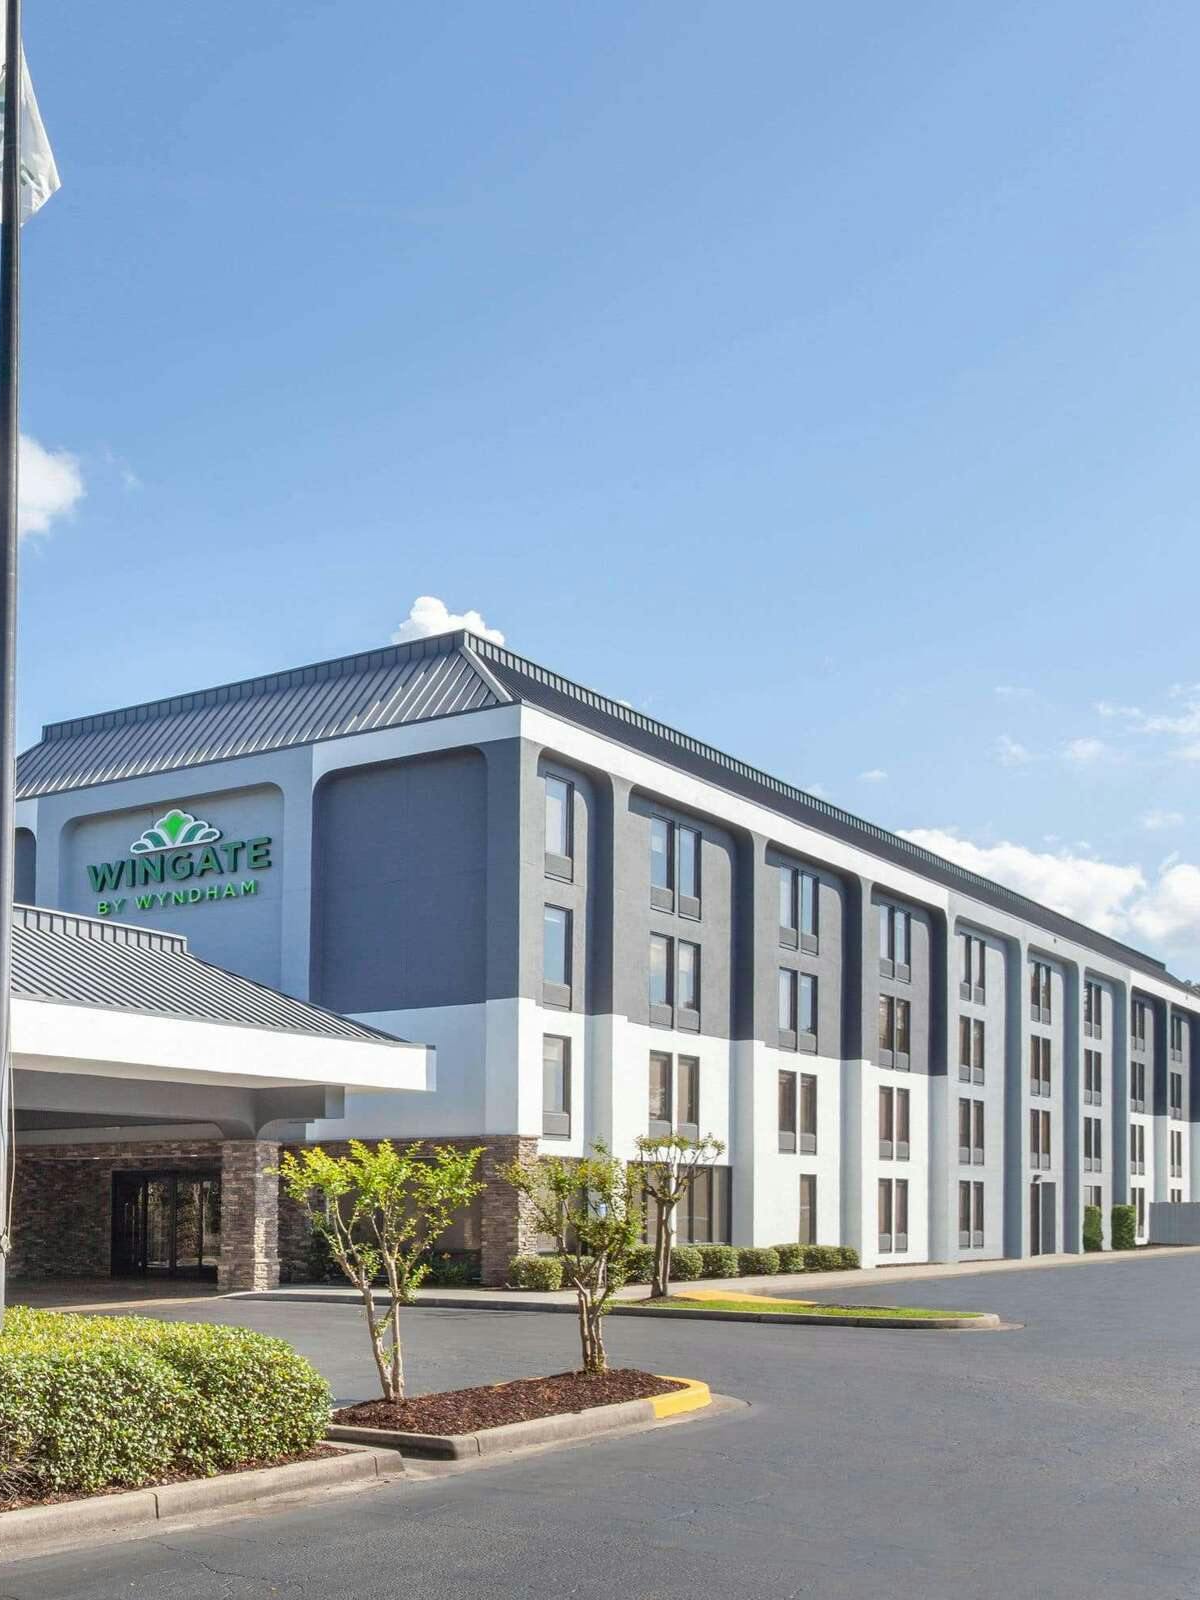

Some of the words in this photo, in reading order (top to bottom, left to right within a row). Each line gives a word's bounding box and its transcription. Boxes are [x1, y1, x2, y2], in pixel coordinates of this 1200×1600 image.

[87, 837, 272, 892] WINGATE
[97, 899, 123, 915] BY
[136, 880, 256, 911] WYNDHAM
